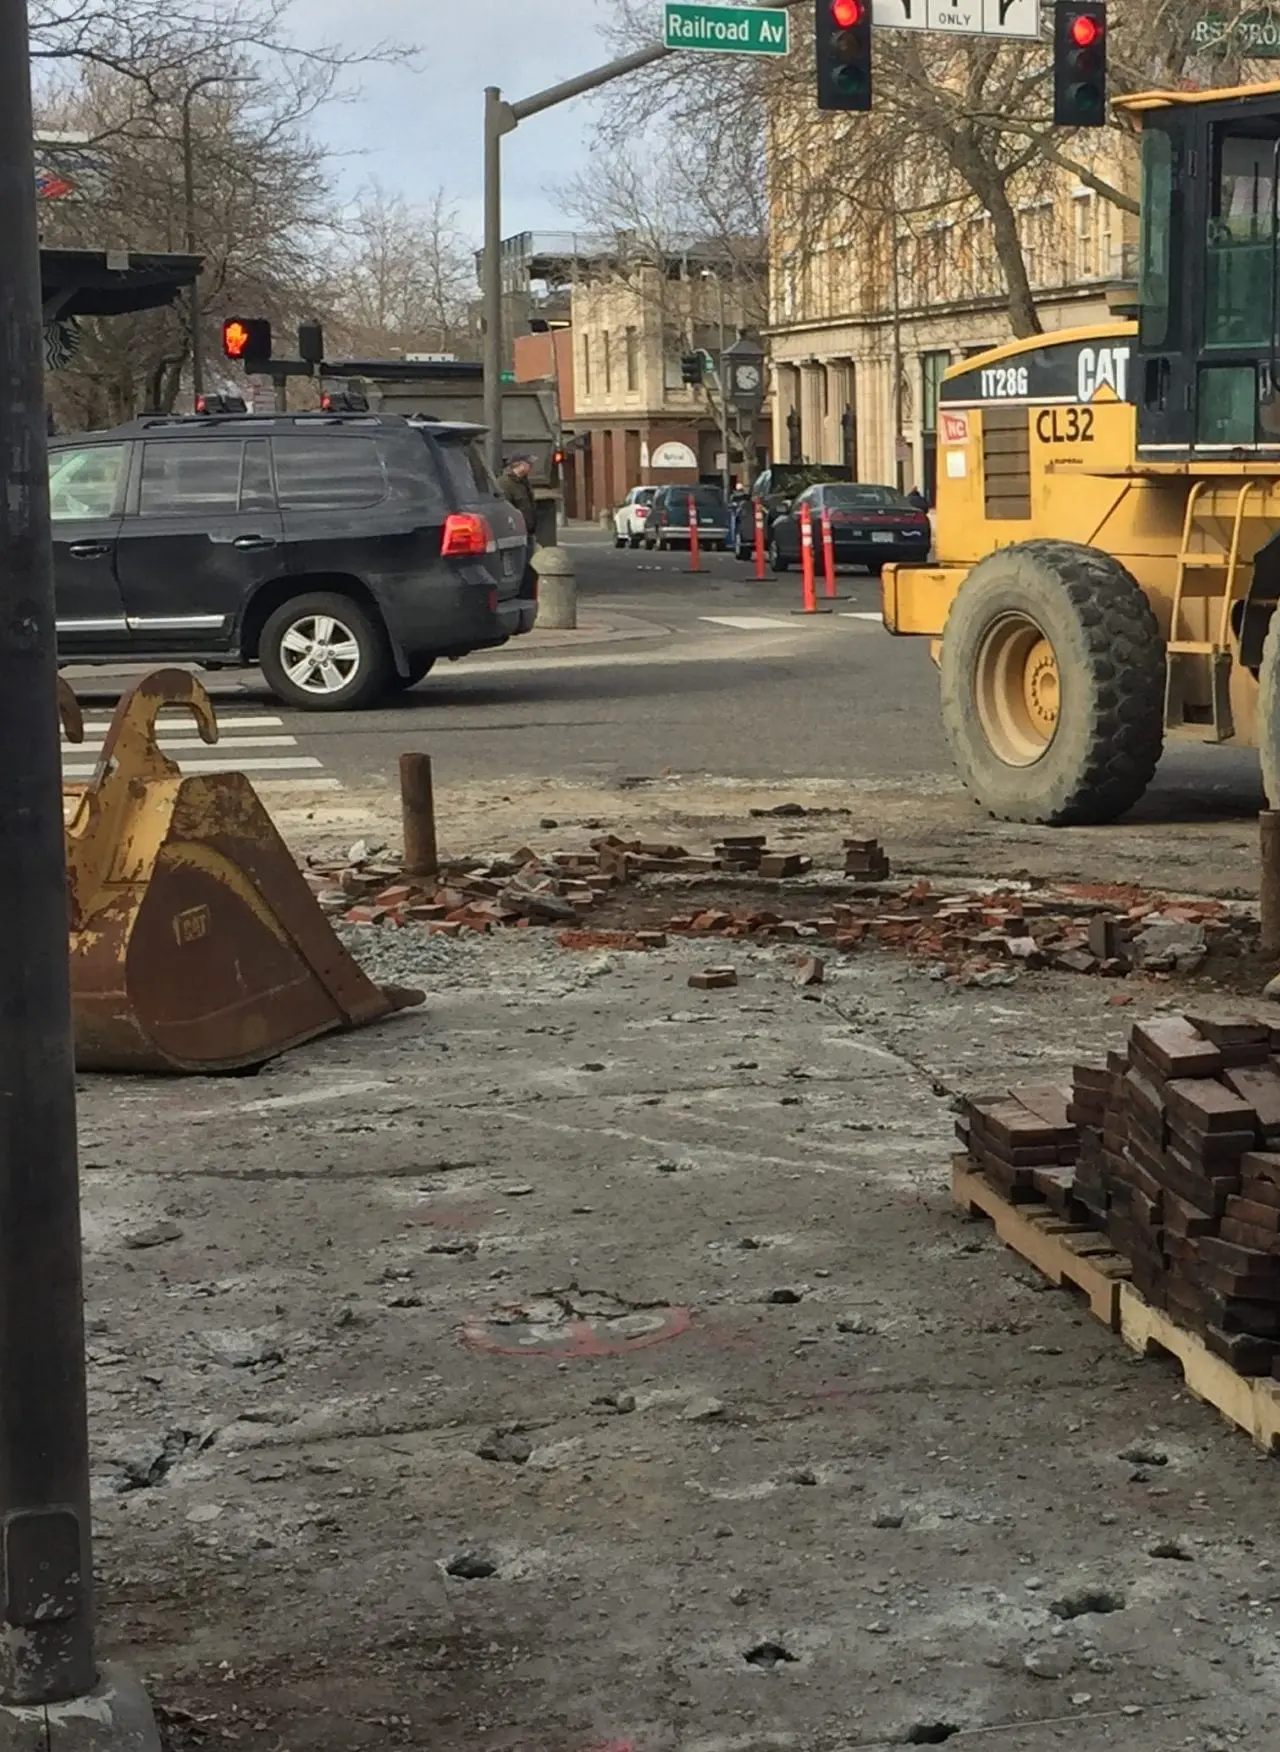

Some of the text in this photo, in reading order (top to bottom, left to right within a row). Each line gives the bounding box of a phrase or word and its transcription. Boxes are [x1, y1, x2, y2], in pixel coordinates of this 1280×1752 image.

[668, 13, 784, 43] Railroad Av
[938, 12, 972, 26] ONLY
[981, 366, 1028, 397] IT28G
[1077, 347, 1130, 402] CAT
[1036, 407, 1094, 444] CL32
